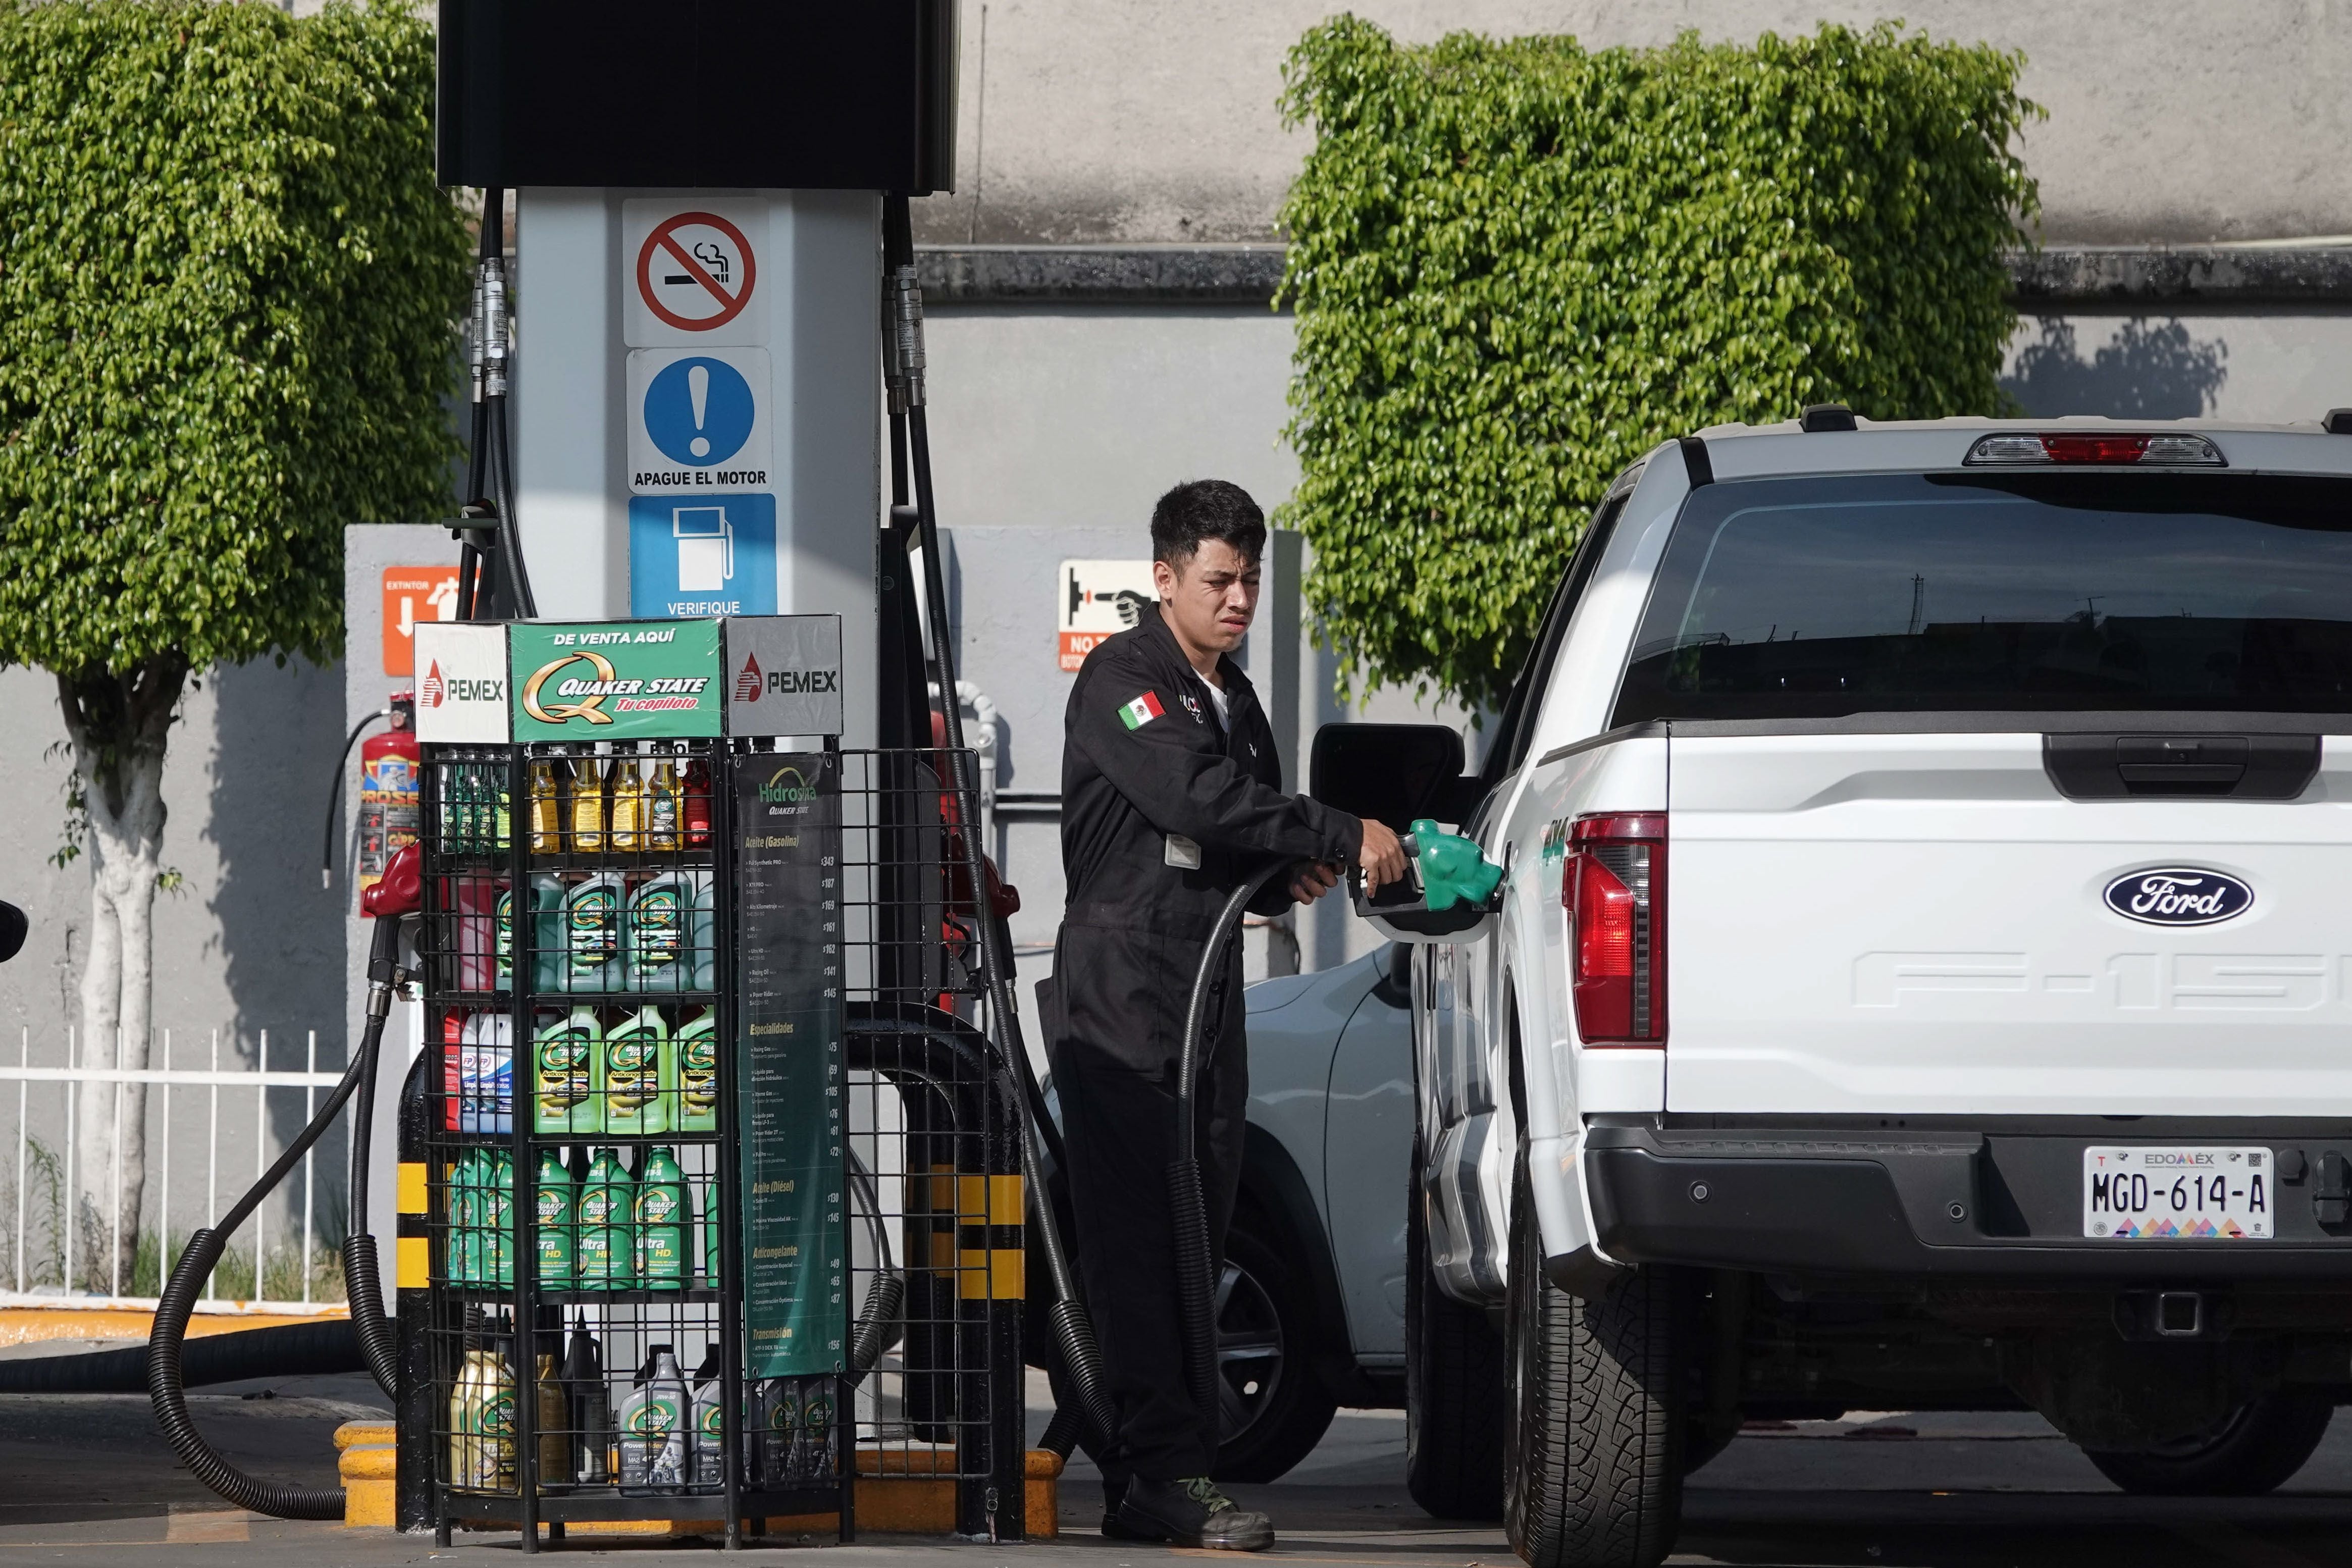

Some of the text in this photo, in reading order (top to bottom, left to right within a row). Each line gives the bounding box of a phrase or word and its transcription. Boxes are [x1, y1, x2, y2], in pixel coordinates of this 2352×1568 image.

[635, 471, 766, 485] APAGUE EL MOTOR
[386, 581, 429, 590] EXTINTOR
[668, 601, 740, 615] VERIFIQUE
[554, 628, 676, 645] DE VENTA AQUÍ
[1071, 636, 1092, 653] NO
[557, 677, 710, 697] QUAKER STATE
[768, 671, 836, 694] PEMEX
[448, 680, 503, 701] PEMEX
[614, 696, 699, 711] Tu copiloto
[759, 783, 816, 803] Hidrosina
[769, 807, 795, 815] QUAKER
[745, 835, 799, 849] Aceite (Gasolina)
[821, 857, 834, 866] $343
[822, 878, 834, 888] $187
[2130, 875, 2226, 917] Ford
[822, 901, 834, 910] $169
[823, 922, 835, 932] $161
[823, 944, 835, 954] $162
[824, 966, 835, 976] $141
[1852, 951, 2352, 1010] F-15
[824, 988, 836, 998] $145
[750, 1022, 794, 1036] Especialidades
[829, 1042, 837, 1052] $75
[825, 1086, 838, 1096] $105
[829, 1109, 838, 1119] $76
[830, 1147, 839, 1156] $72
[2098, 1153, 2214, 1167] T EDOMÉX
[753, 1180, 794, 1194] Aceite (Diésel)
[828, 1193, 839, 1203] $130
[2093, 1173, 2265, 1213] MGD-614-A
[828, 1213, 839, 1223] $145
[637, 1238, 665, 1249] Utra
[545, 1250, 561, 1258] HD
[753, 1246, 798, 1259] Anticongelante
[830, 1259, 840, 1269] $49
[830, 1276, 840, 1286] $65
[831, 1293, 840, 1303] $87
[753, 1327, 792, 1340] Transmisión
[828, 1340, 840, 1350] $156
